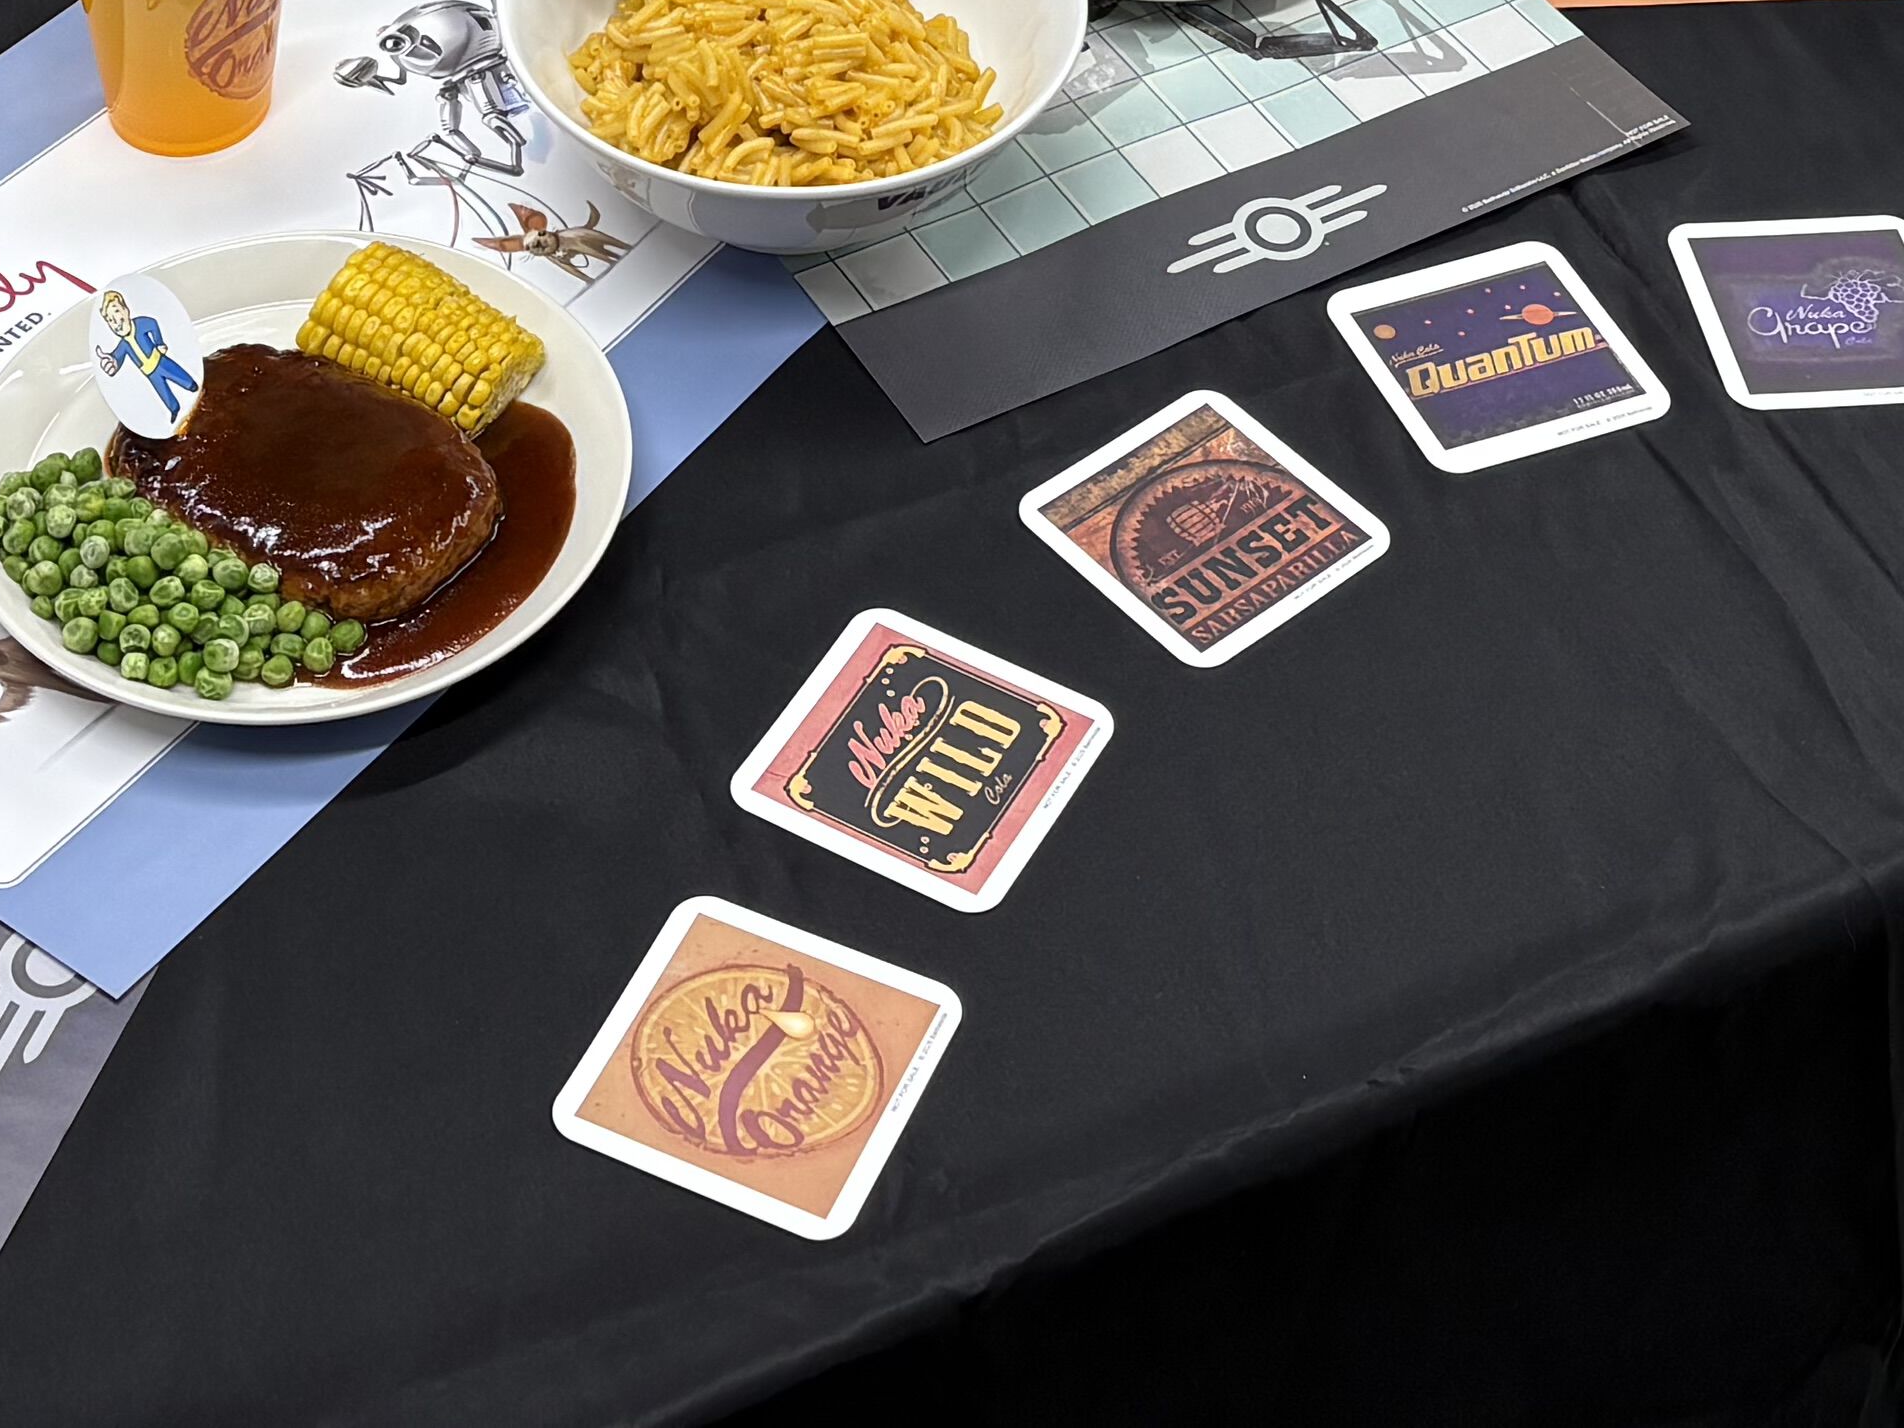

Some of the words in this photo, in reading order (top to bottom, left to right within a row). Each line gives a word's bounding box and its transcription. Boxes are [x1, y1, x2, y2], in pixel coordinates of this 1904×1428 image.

[1747, 306, 1876, 349] Grape
[1786, 304, 1849, 320] Nuka
[1151, 491, 1340, 627] SUNSET
[1190, 526, 1362, 648] SARSAPARILLA
[848, 693, 927, 791] Nuka
[882, 699, 1023, 838] WILD
[984, 771, 1016, 806] Cola
[656, 980, 776, 1140] Nuka
[740, 1006, 863, 1152] Orange
